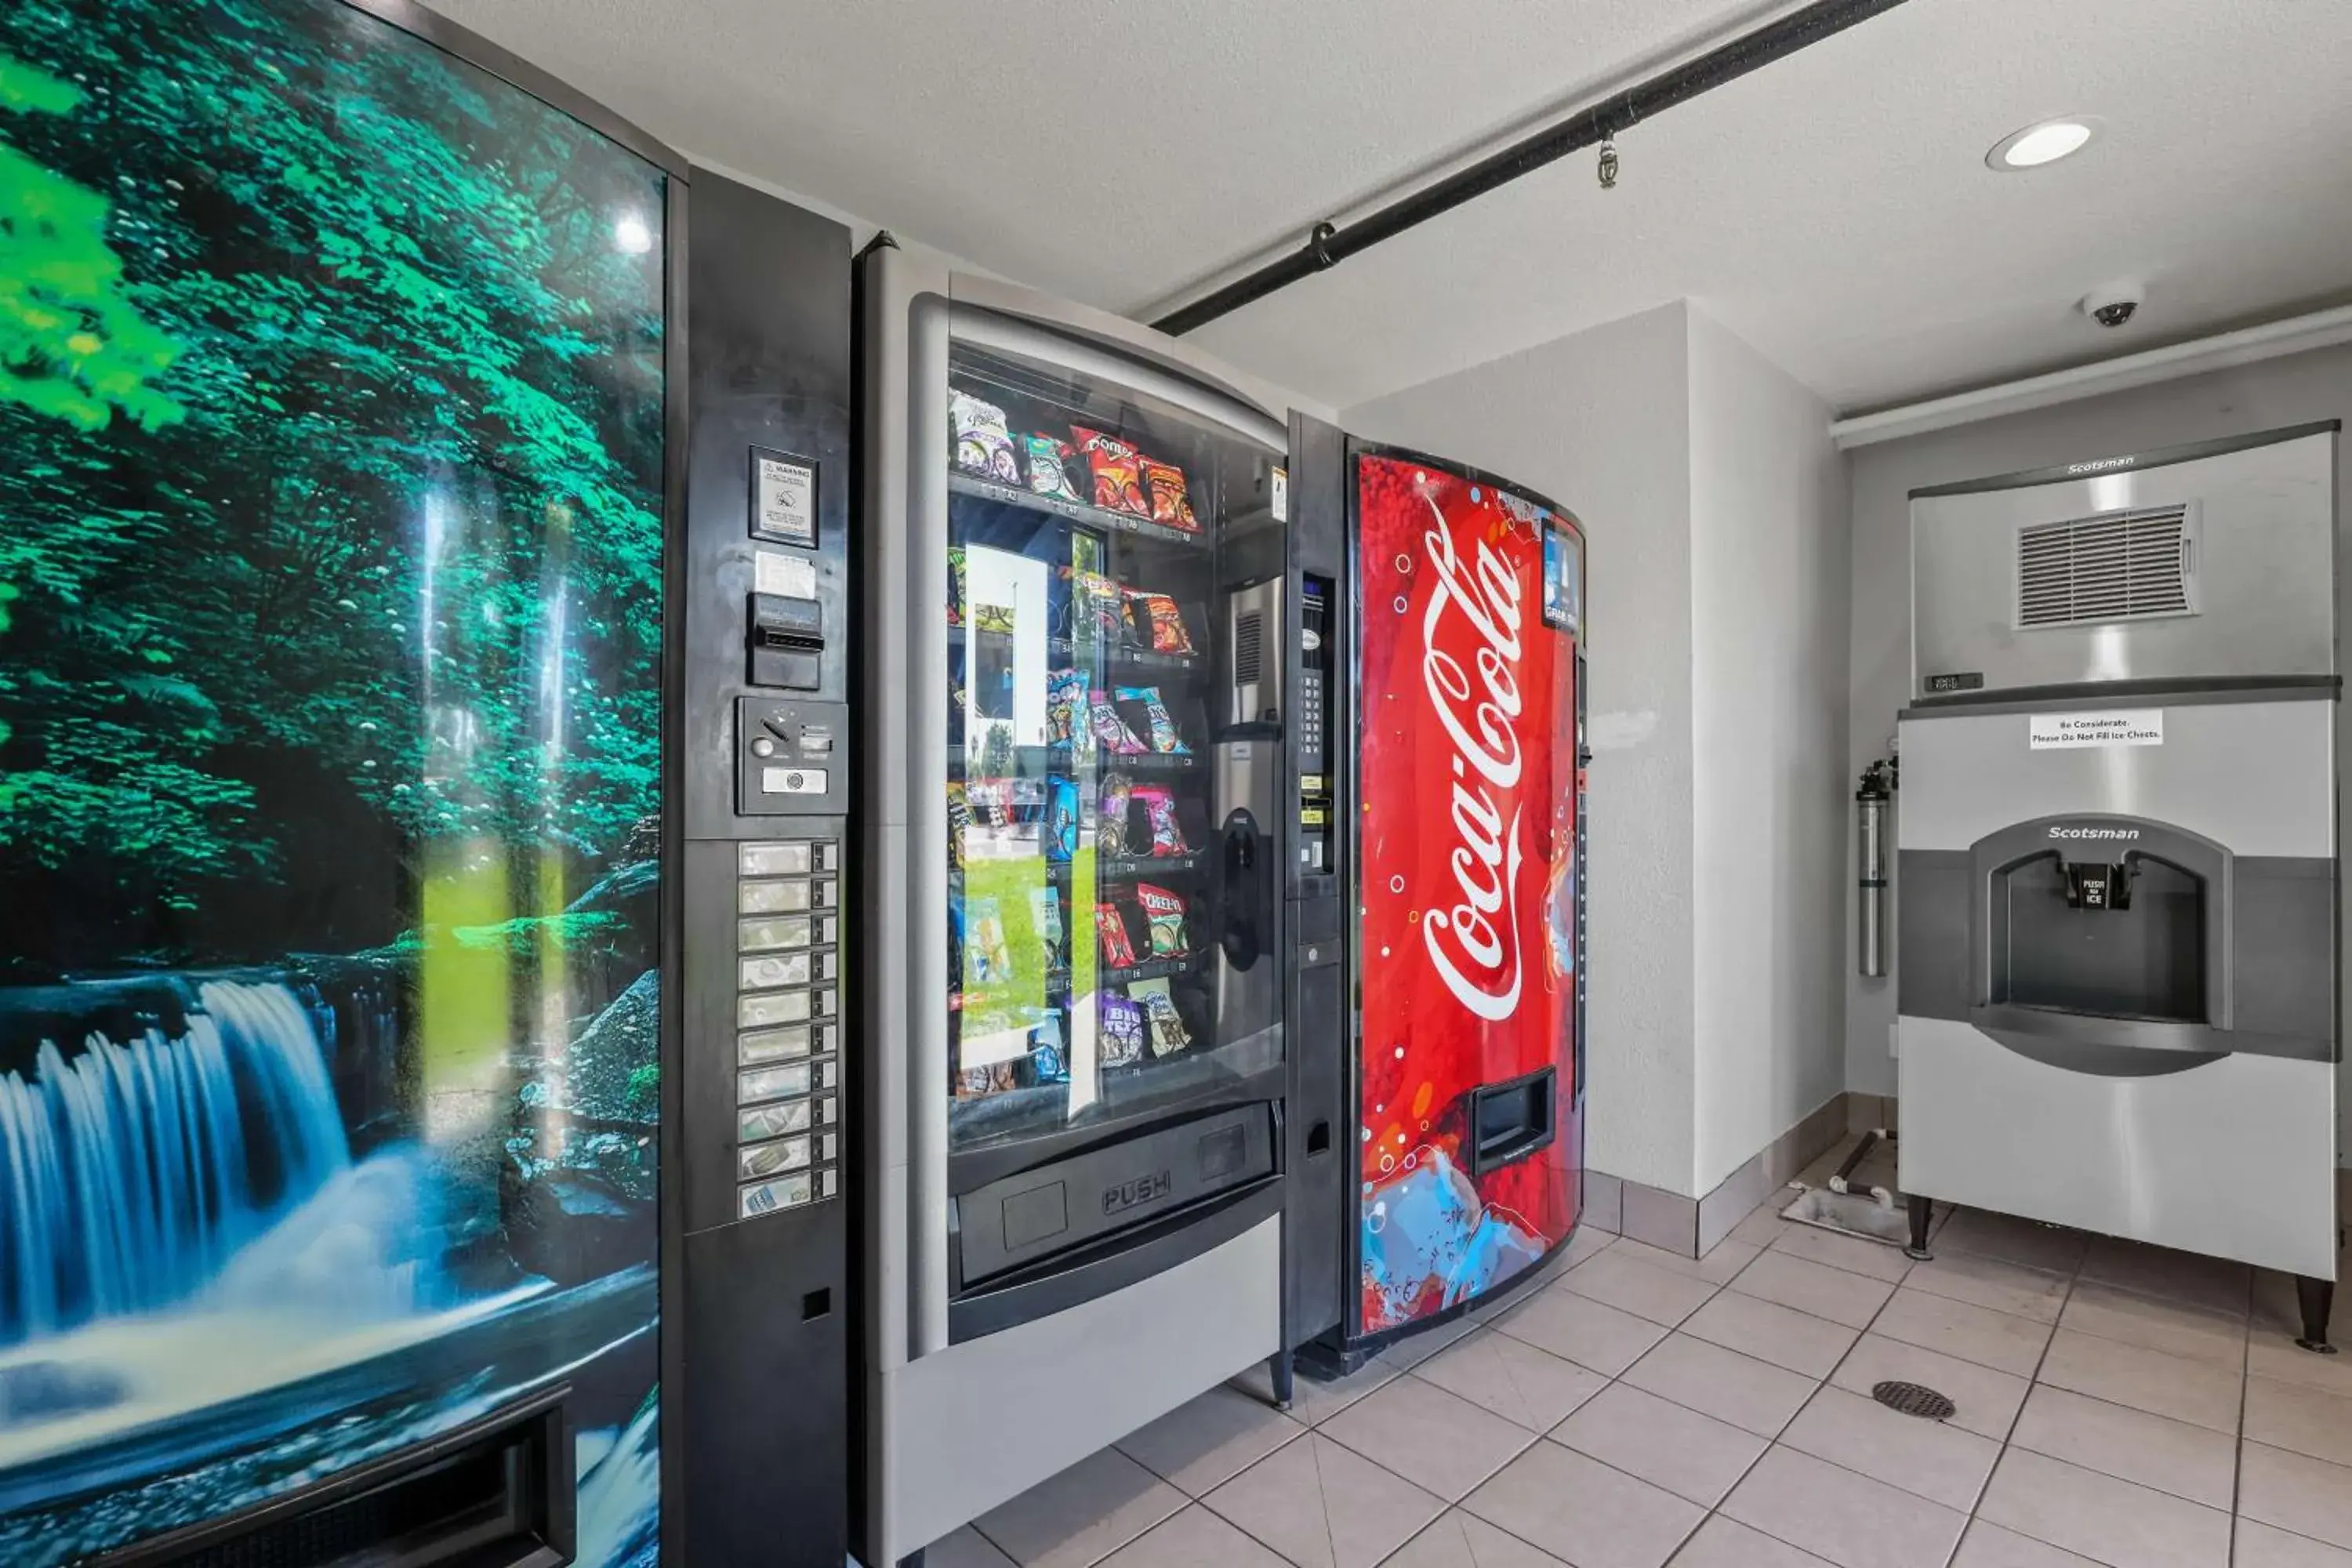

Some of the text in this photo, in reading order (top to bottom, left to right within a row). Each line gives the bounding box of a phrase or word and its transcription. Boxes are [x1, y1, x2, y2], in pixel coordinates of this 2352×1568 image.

[2067, 456, 2134, 474] Scotsman
[2074, 719, 2130, 729] Considerate.
[2032, 734, 2060, 743] Please
[2061, 733, 2074, 742] Do
[2096, 731, 2110, 740] Fill
[1423, 493, 1523, 1021] Coca-Cola
[2048, 826, 2140, 840] Scotsman
[2083, 880, 2105, 888] PUSH
[2086, 895, 2102, 904] ICE
[1105, 1172, 1167, 1212] PUSH
